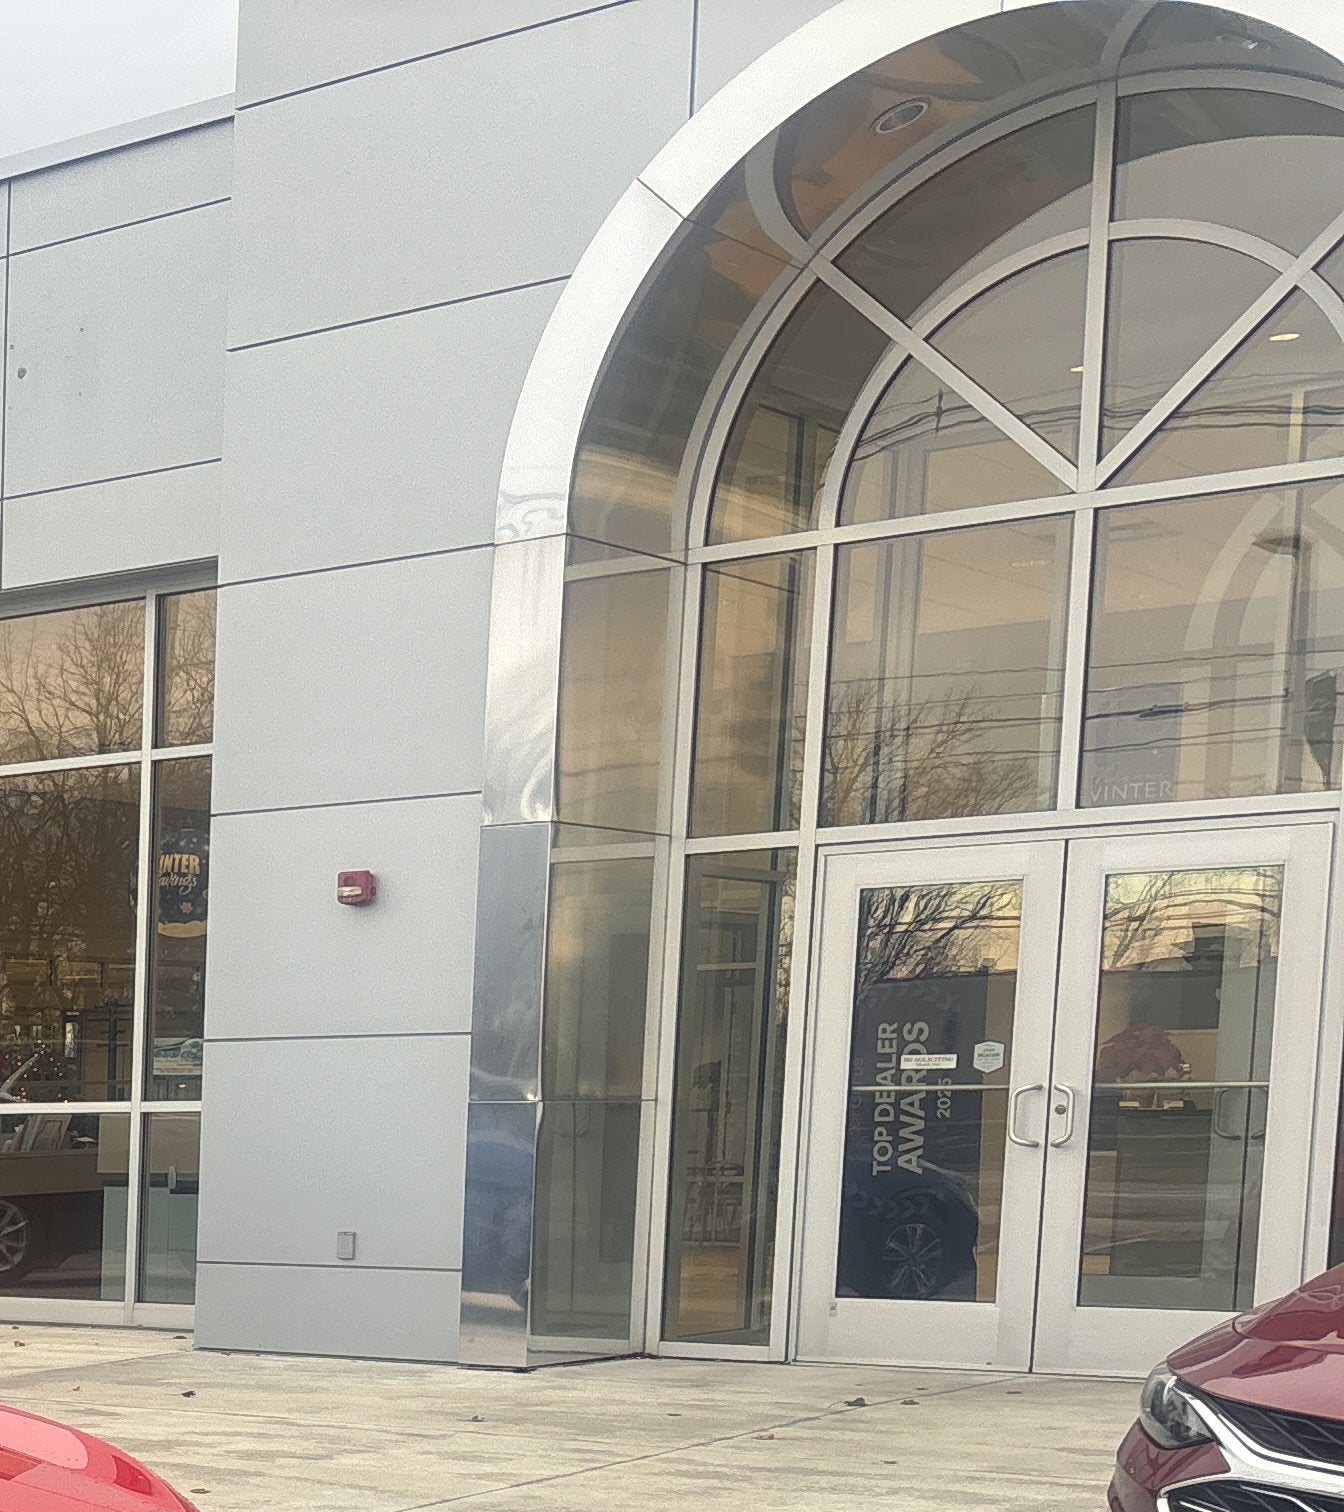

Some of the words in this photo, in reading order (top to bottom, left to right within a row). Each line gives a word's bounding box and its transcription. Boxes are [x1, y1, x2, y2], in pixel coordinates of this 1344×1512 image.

[159, 853, 201, 875] INTER
[159, 872, 198, 895] avings
[874, 1022, 898, 1122] DEALER
[897, 1021, 929, 1176] AWARDS
[936, 1077, 953, 1120] 2025
[872, 1126, 894, 1176] TOP
